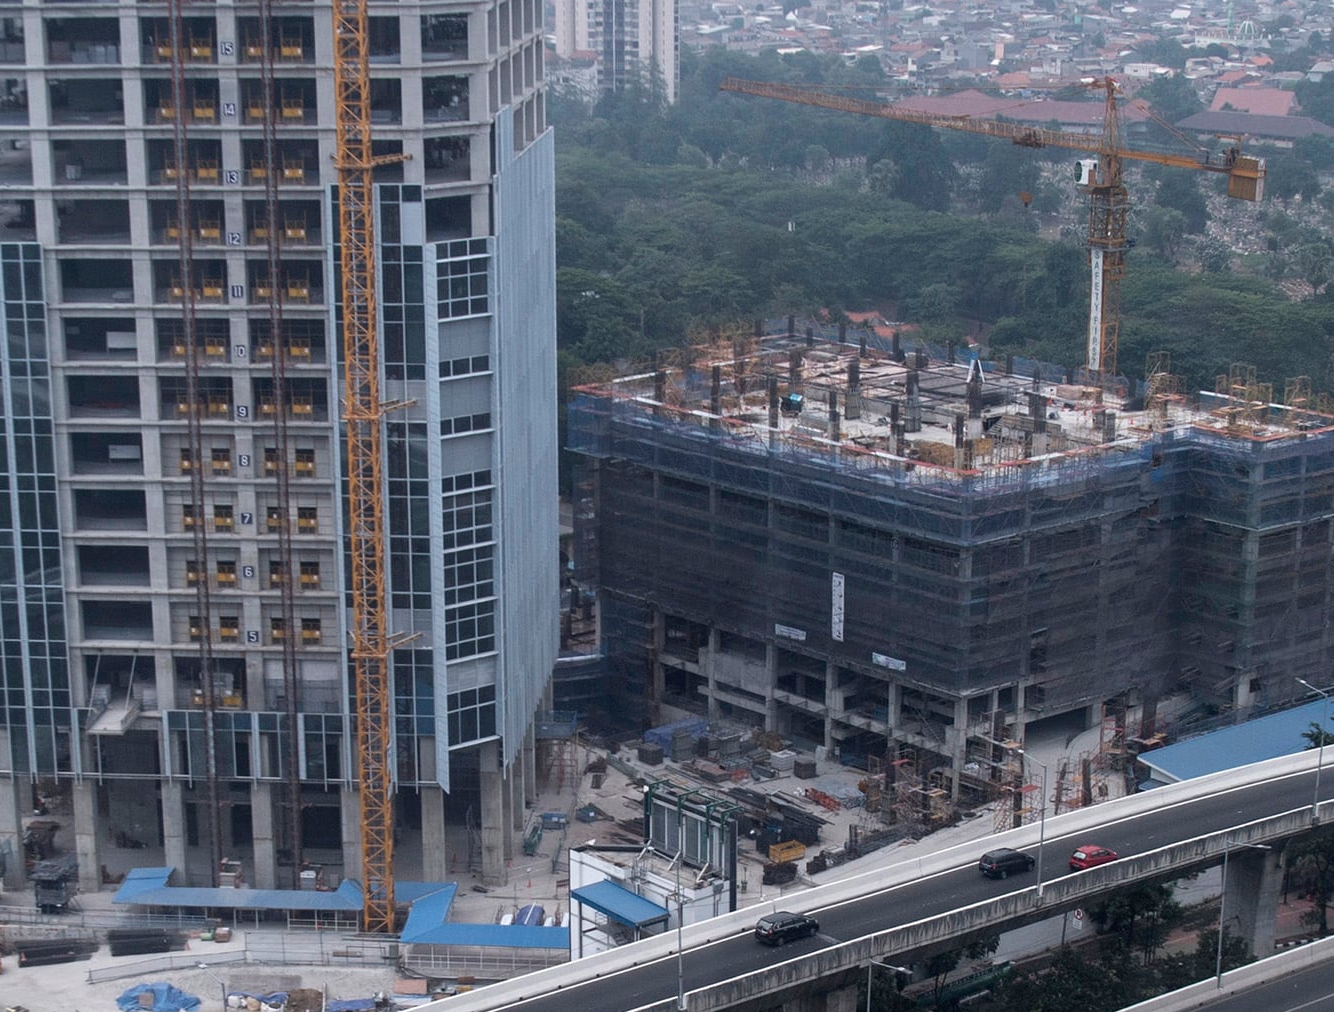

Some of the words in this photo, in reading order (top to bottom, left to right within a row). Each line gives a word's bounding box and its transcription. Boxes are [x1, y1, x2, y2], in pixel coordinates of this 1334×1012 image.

[220, 41, 233, 56] 15
[223, 103, 235, 116] 14
[226, 170, 238, 183] 13
[228, 233, 241, 246] 12
[231, 285, 243, 297] 11
[234, 345, 247, 357] 10
[237, 406, 248, 418] 9
[239, 455, 250, 467] 8
[241, 513, 252, 525] 7
[243, 566, 254, 578] 6
[247, 631, 258, 643] 5
